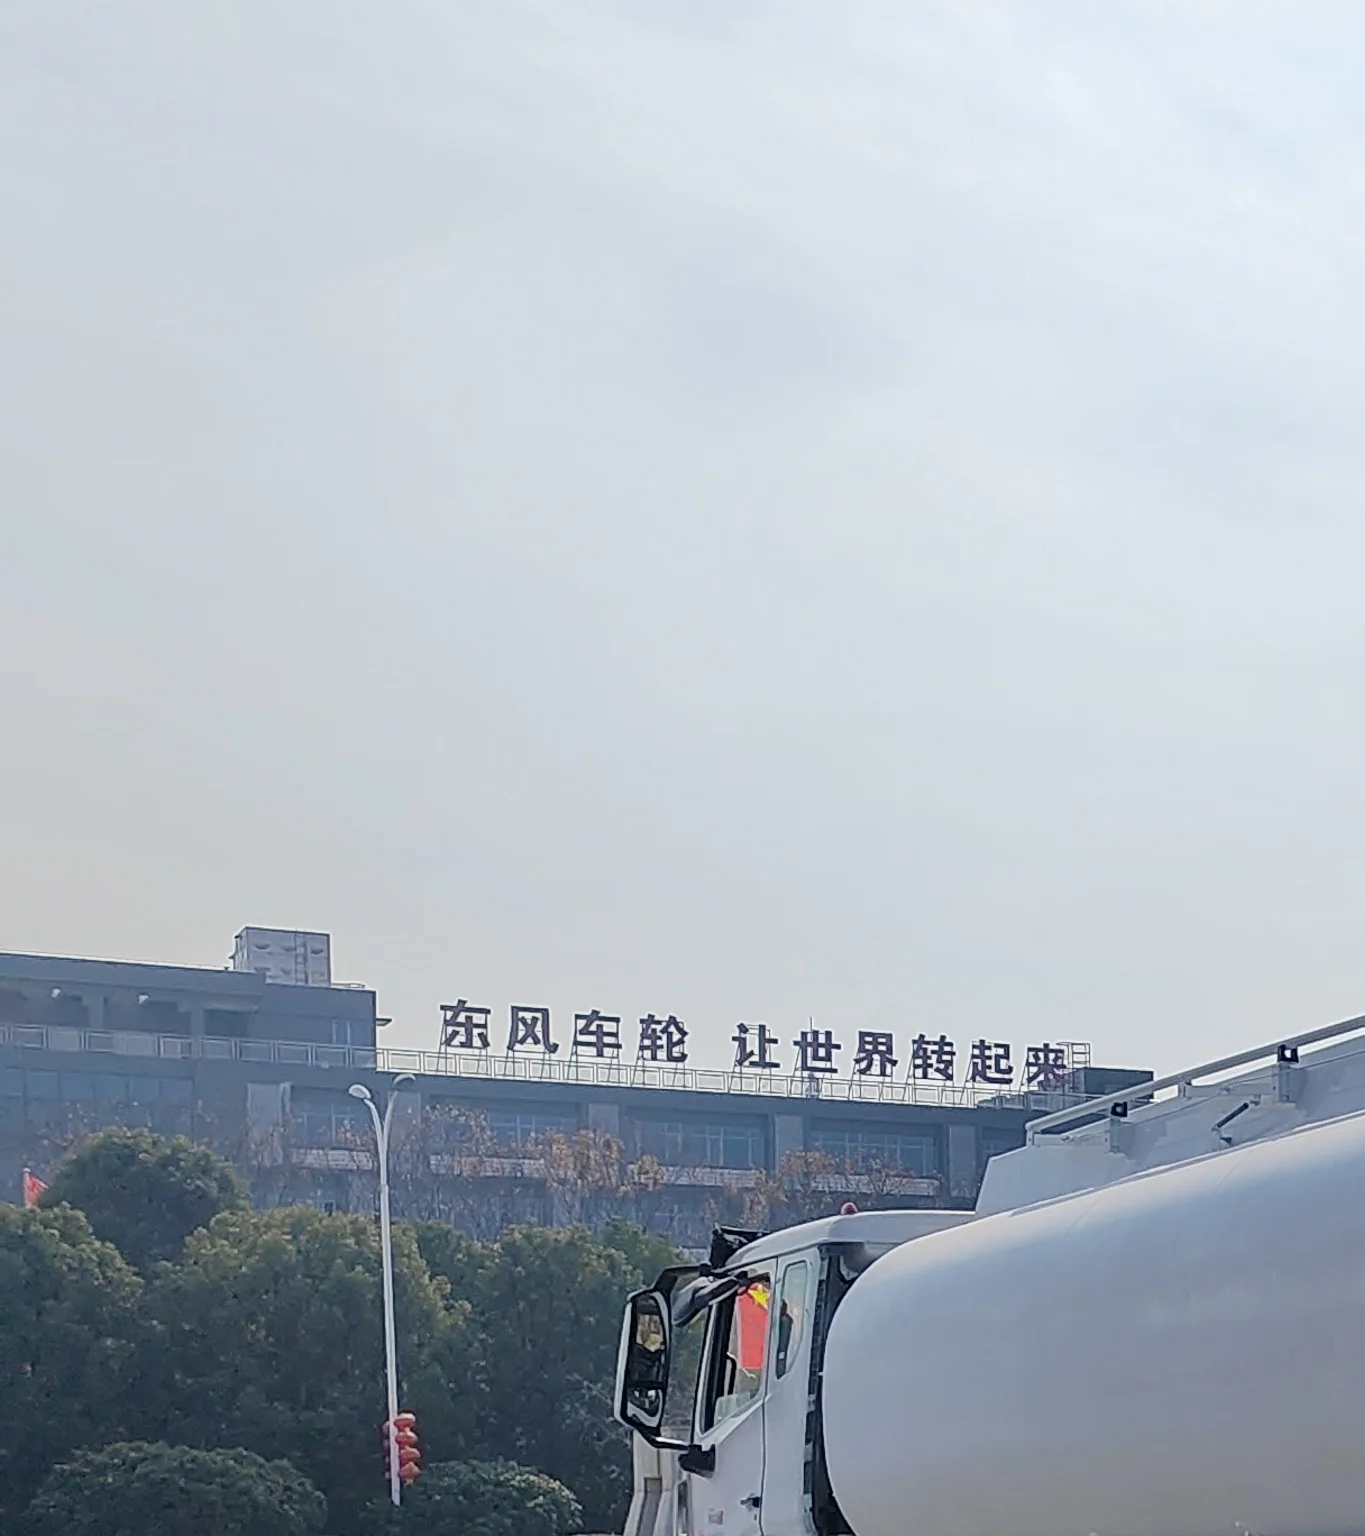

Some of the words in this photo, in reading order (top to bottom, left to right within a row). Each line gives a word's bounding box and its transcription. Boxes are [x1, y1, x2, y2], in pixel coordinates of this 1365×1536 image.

[439, 999, 689, 1063] 东风车轮
[731, 1023, 1068, 1089] 让世界转起来
